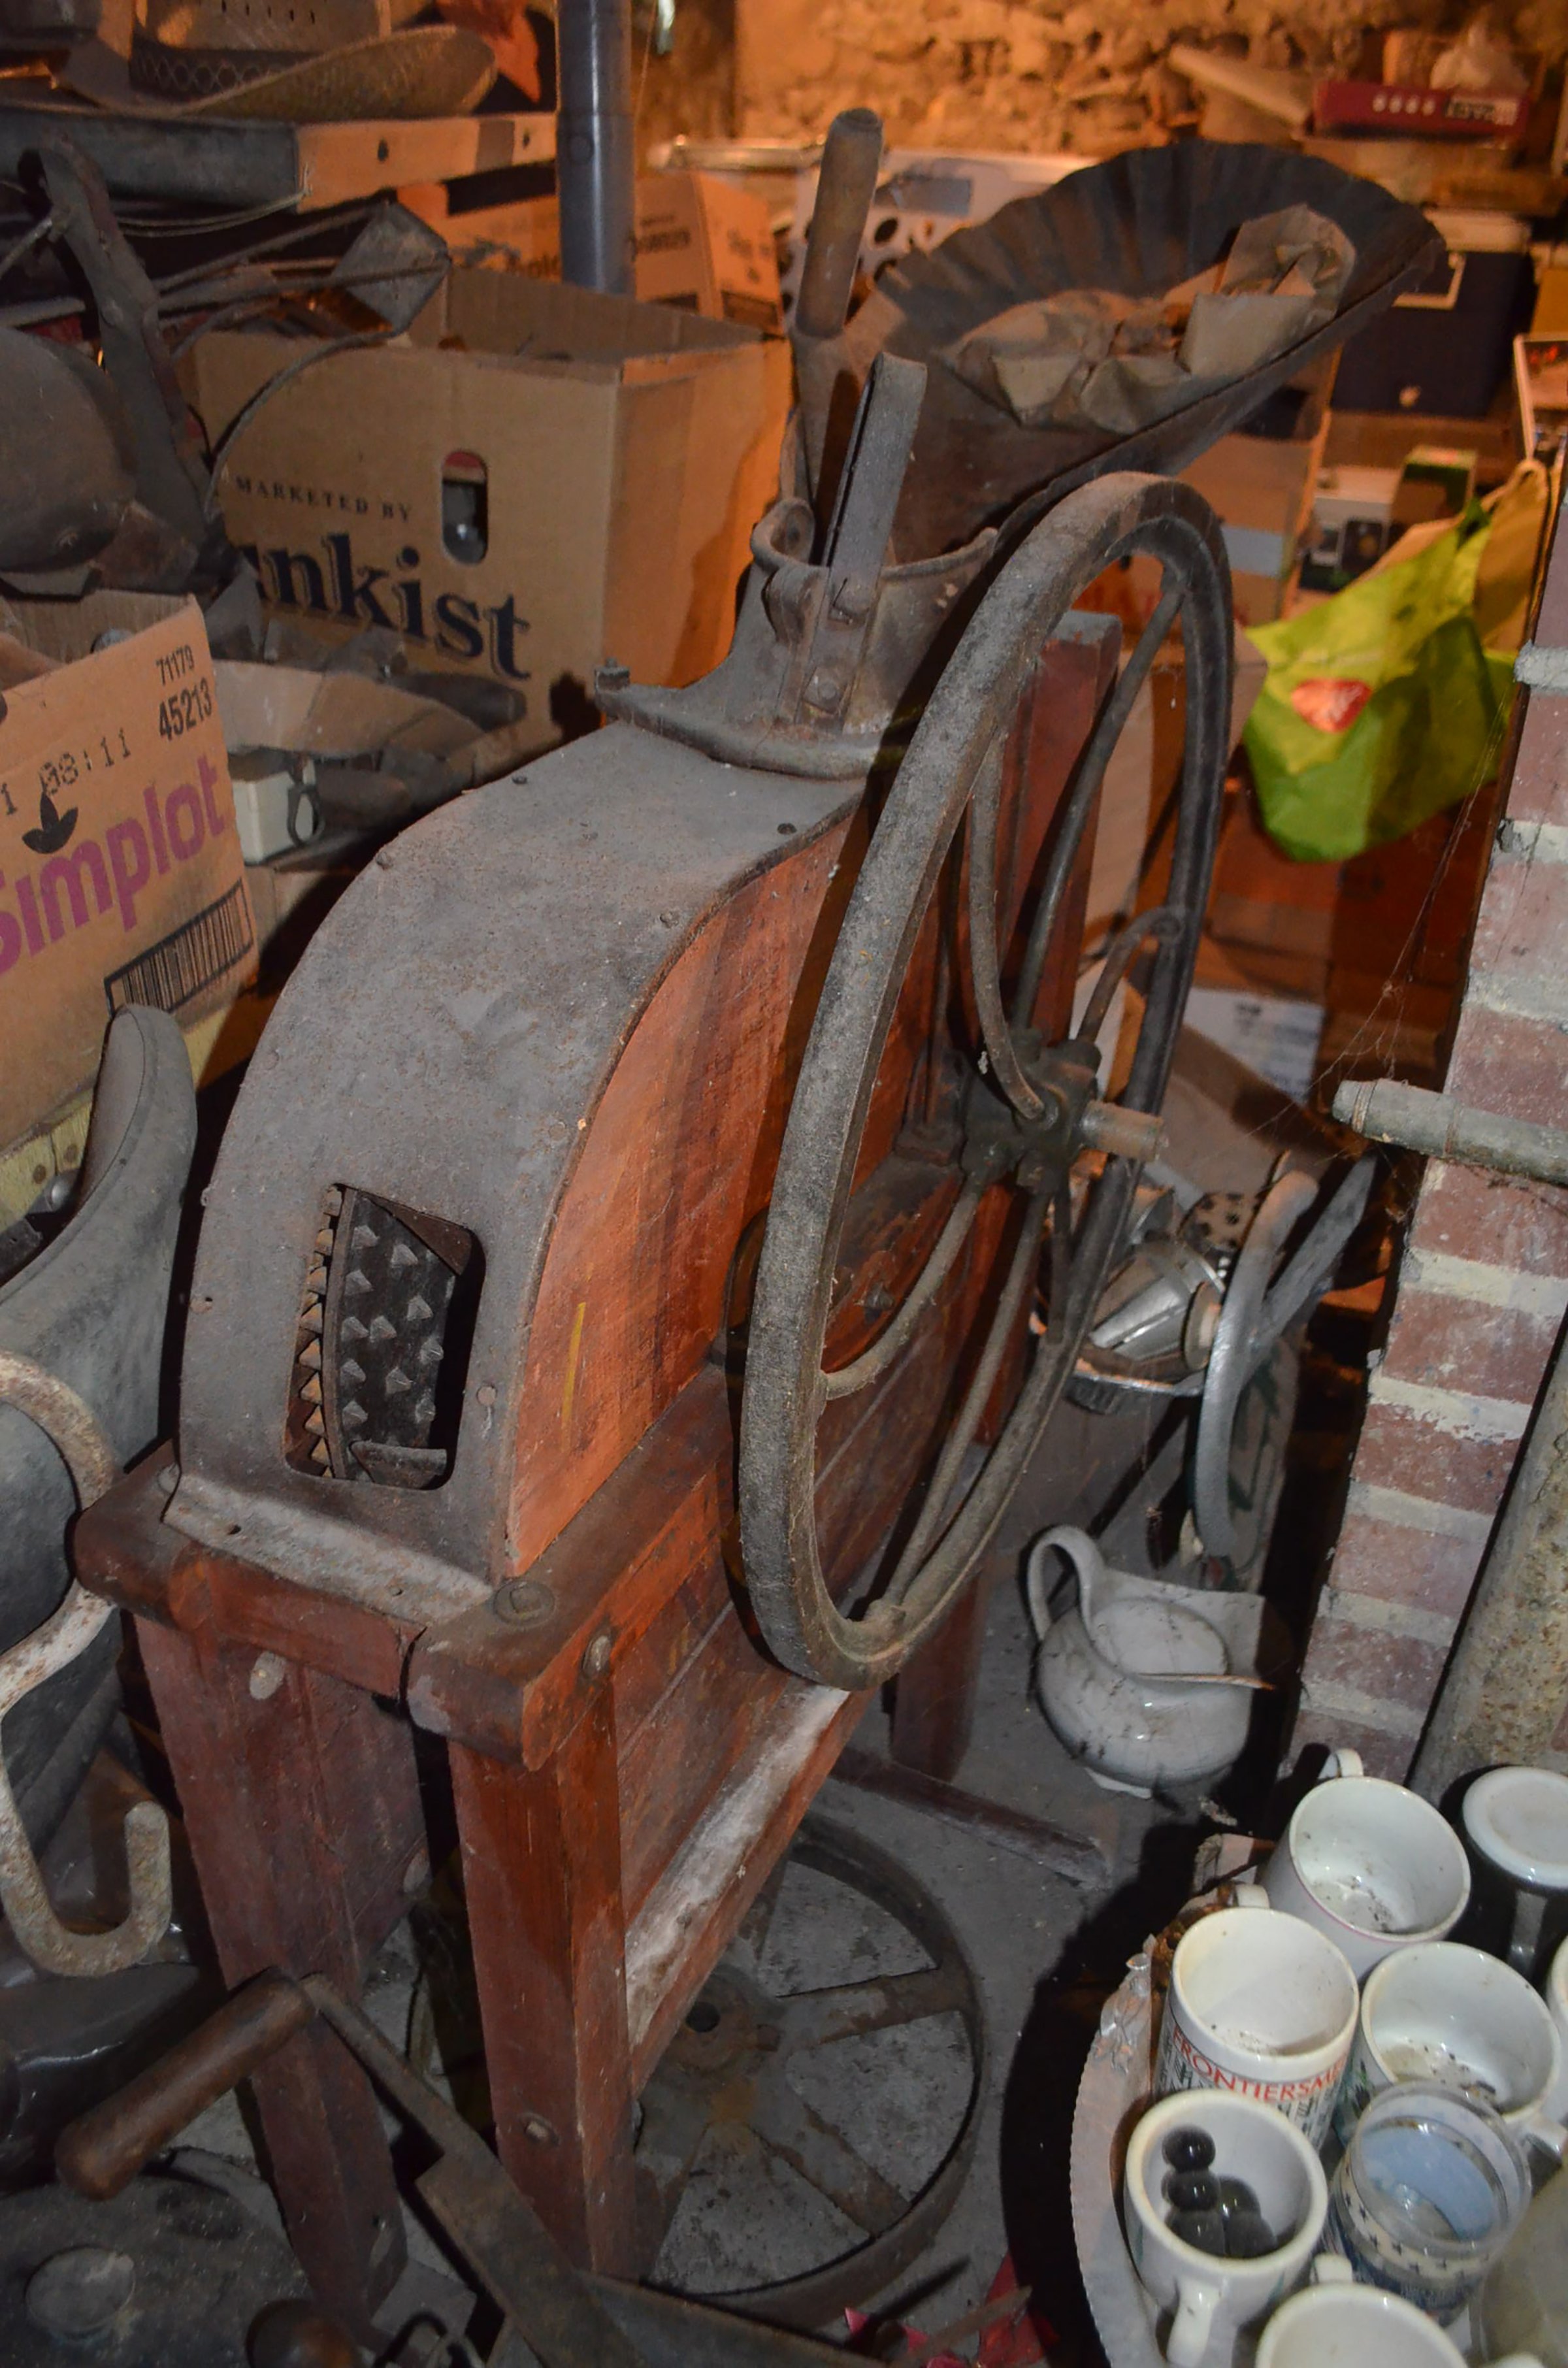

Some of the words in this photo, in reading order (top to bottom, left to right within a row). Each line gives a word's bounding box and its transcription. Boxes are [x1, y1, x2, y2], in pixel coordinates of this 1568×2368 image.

[235, 474, 368, 514] MARKETED
[382, 501, 411, 521] BY
[156, 644, 195, 685] 71179
[158, 677, 212, 741] 45213
